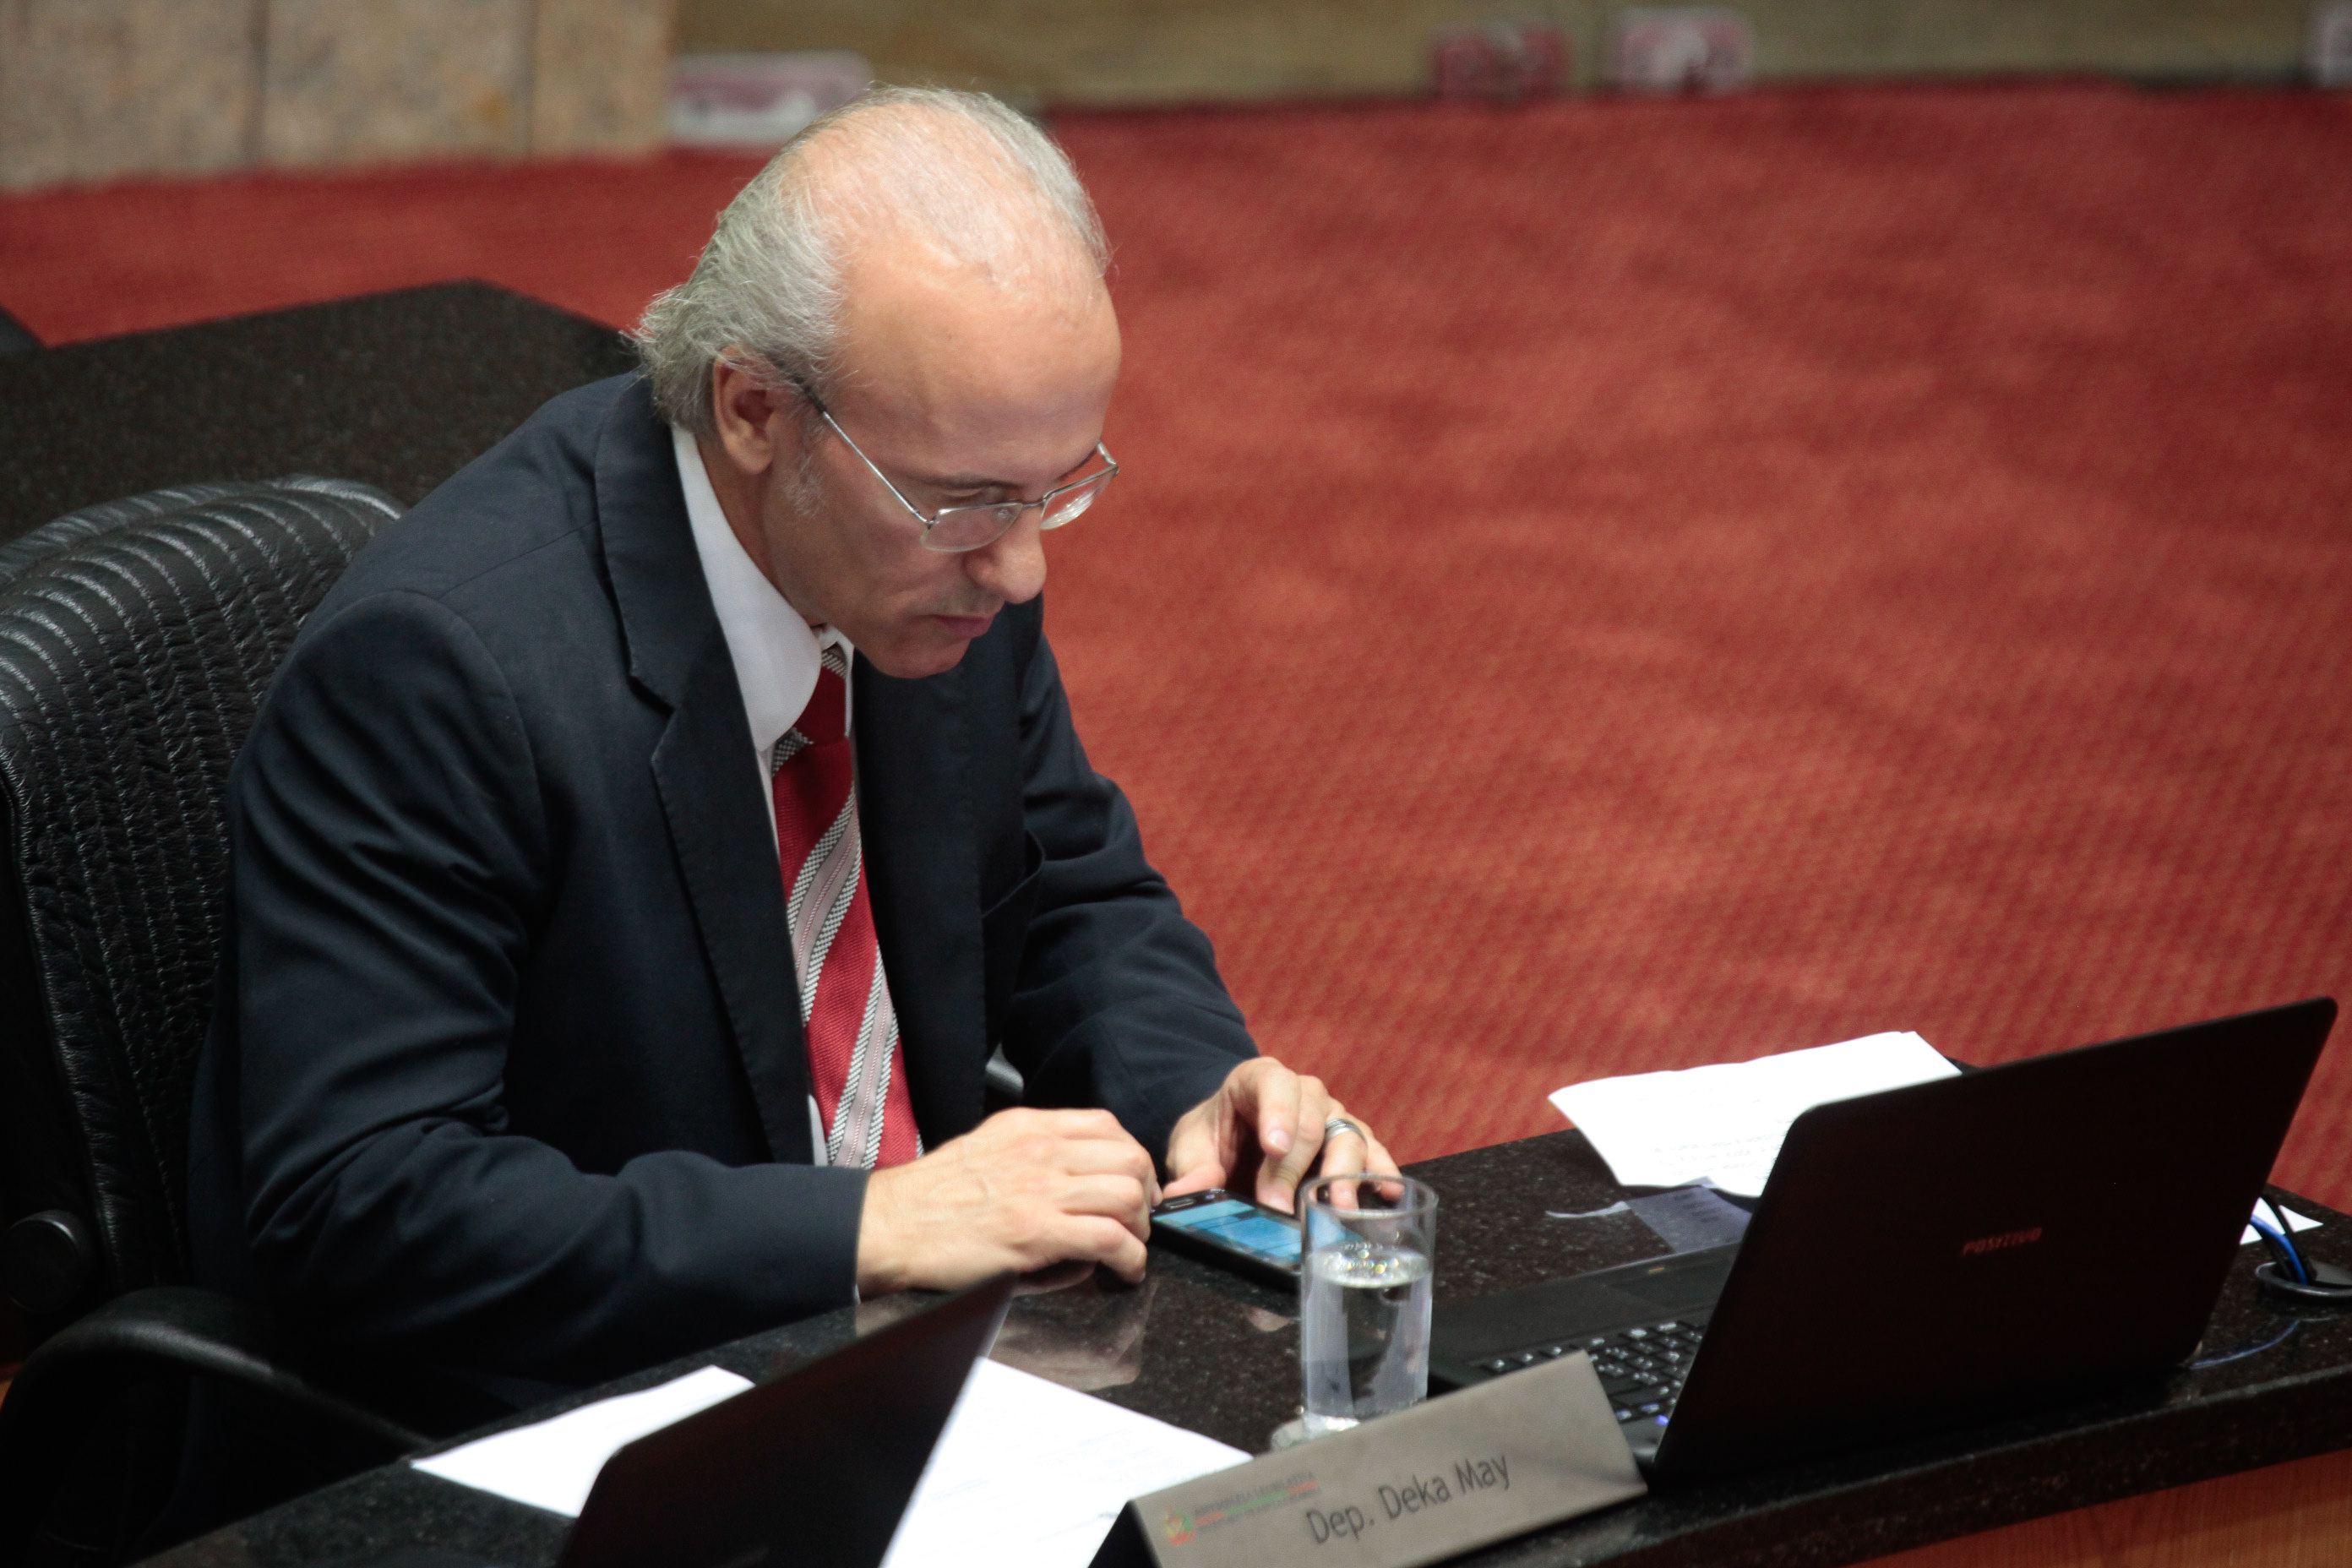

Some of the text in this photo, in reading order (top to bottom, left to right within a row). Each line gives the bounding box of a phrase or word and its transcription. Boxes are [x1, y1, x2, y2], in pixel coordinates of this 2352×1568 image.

[1305, 1505, 1375, 1544] Dep.
[1378, 1474, 1452, 1520] Deka
[1455, 1454, 1511, 1494] May
